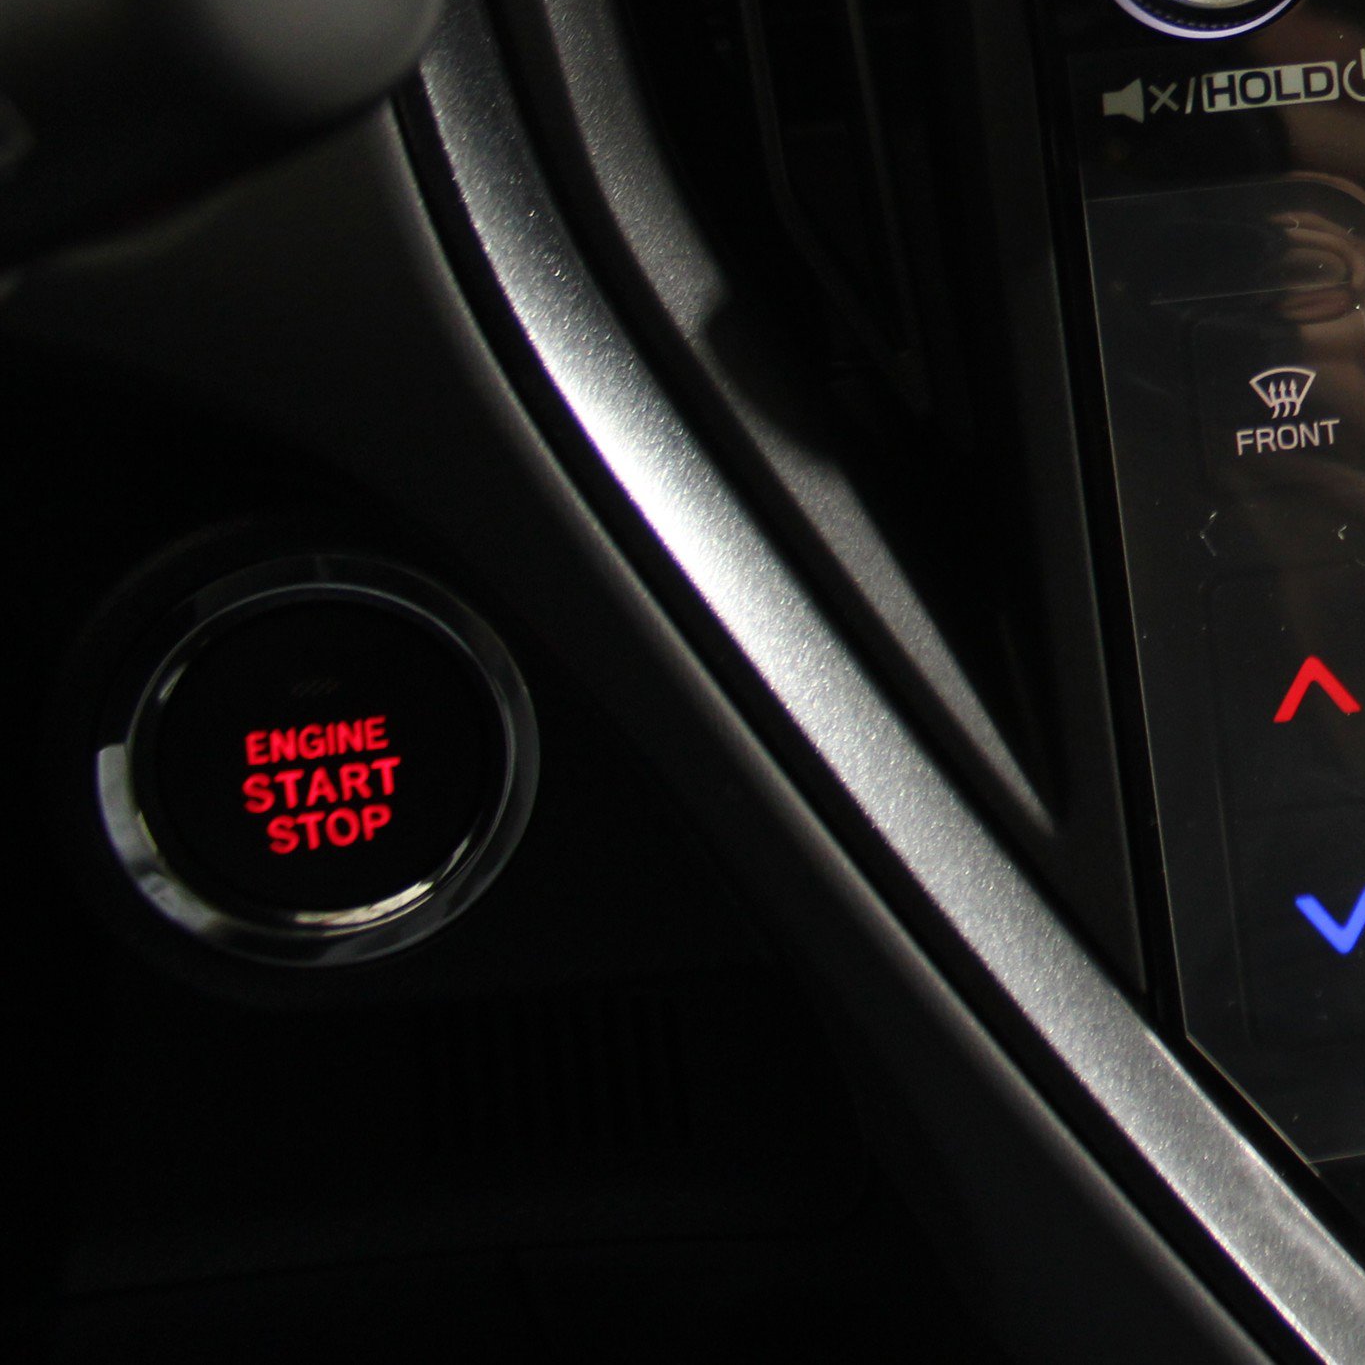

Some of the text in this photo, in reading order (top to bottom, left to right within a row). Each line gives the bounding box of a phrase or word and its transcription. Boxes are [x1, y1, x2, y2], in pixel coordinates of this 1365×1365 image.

[1205, 65, 1334, 107] HOLD
[1236, 418, 1340, 456] FRONT
[244, 715, 389, 766] ENGINE
[242, 756, 400, 813] START
[267, 804, 391, 854] STOP
